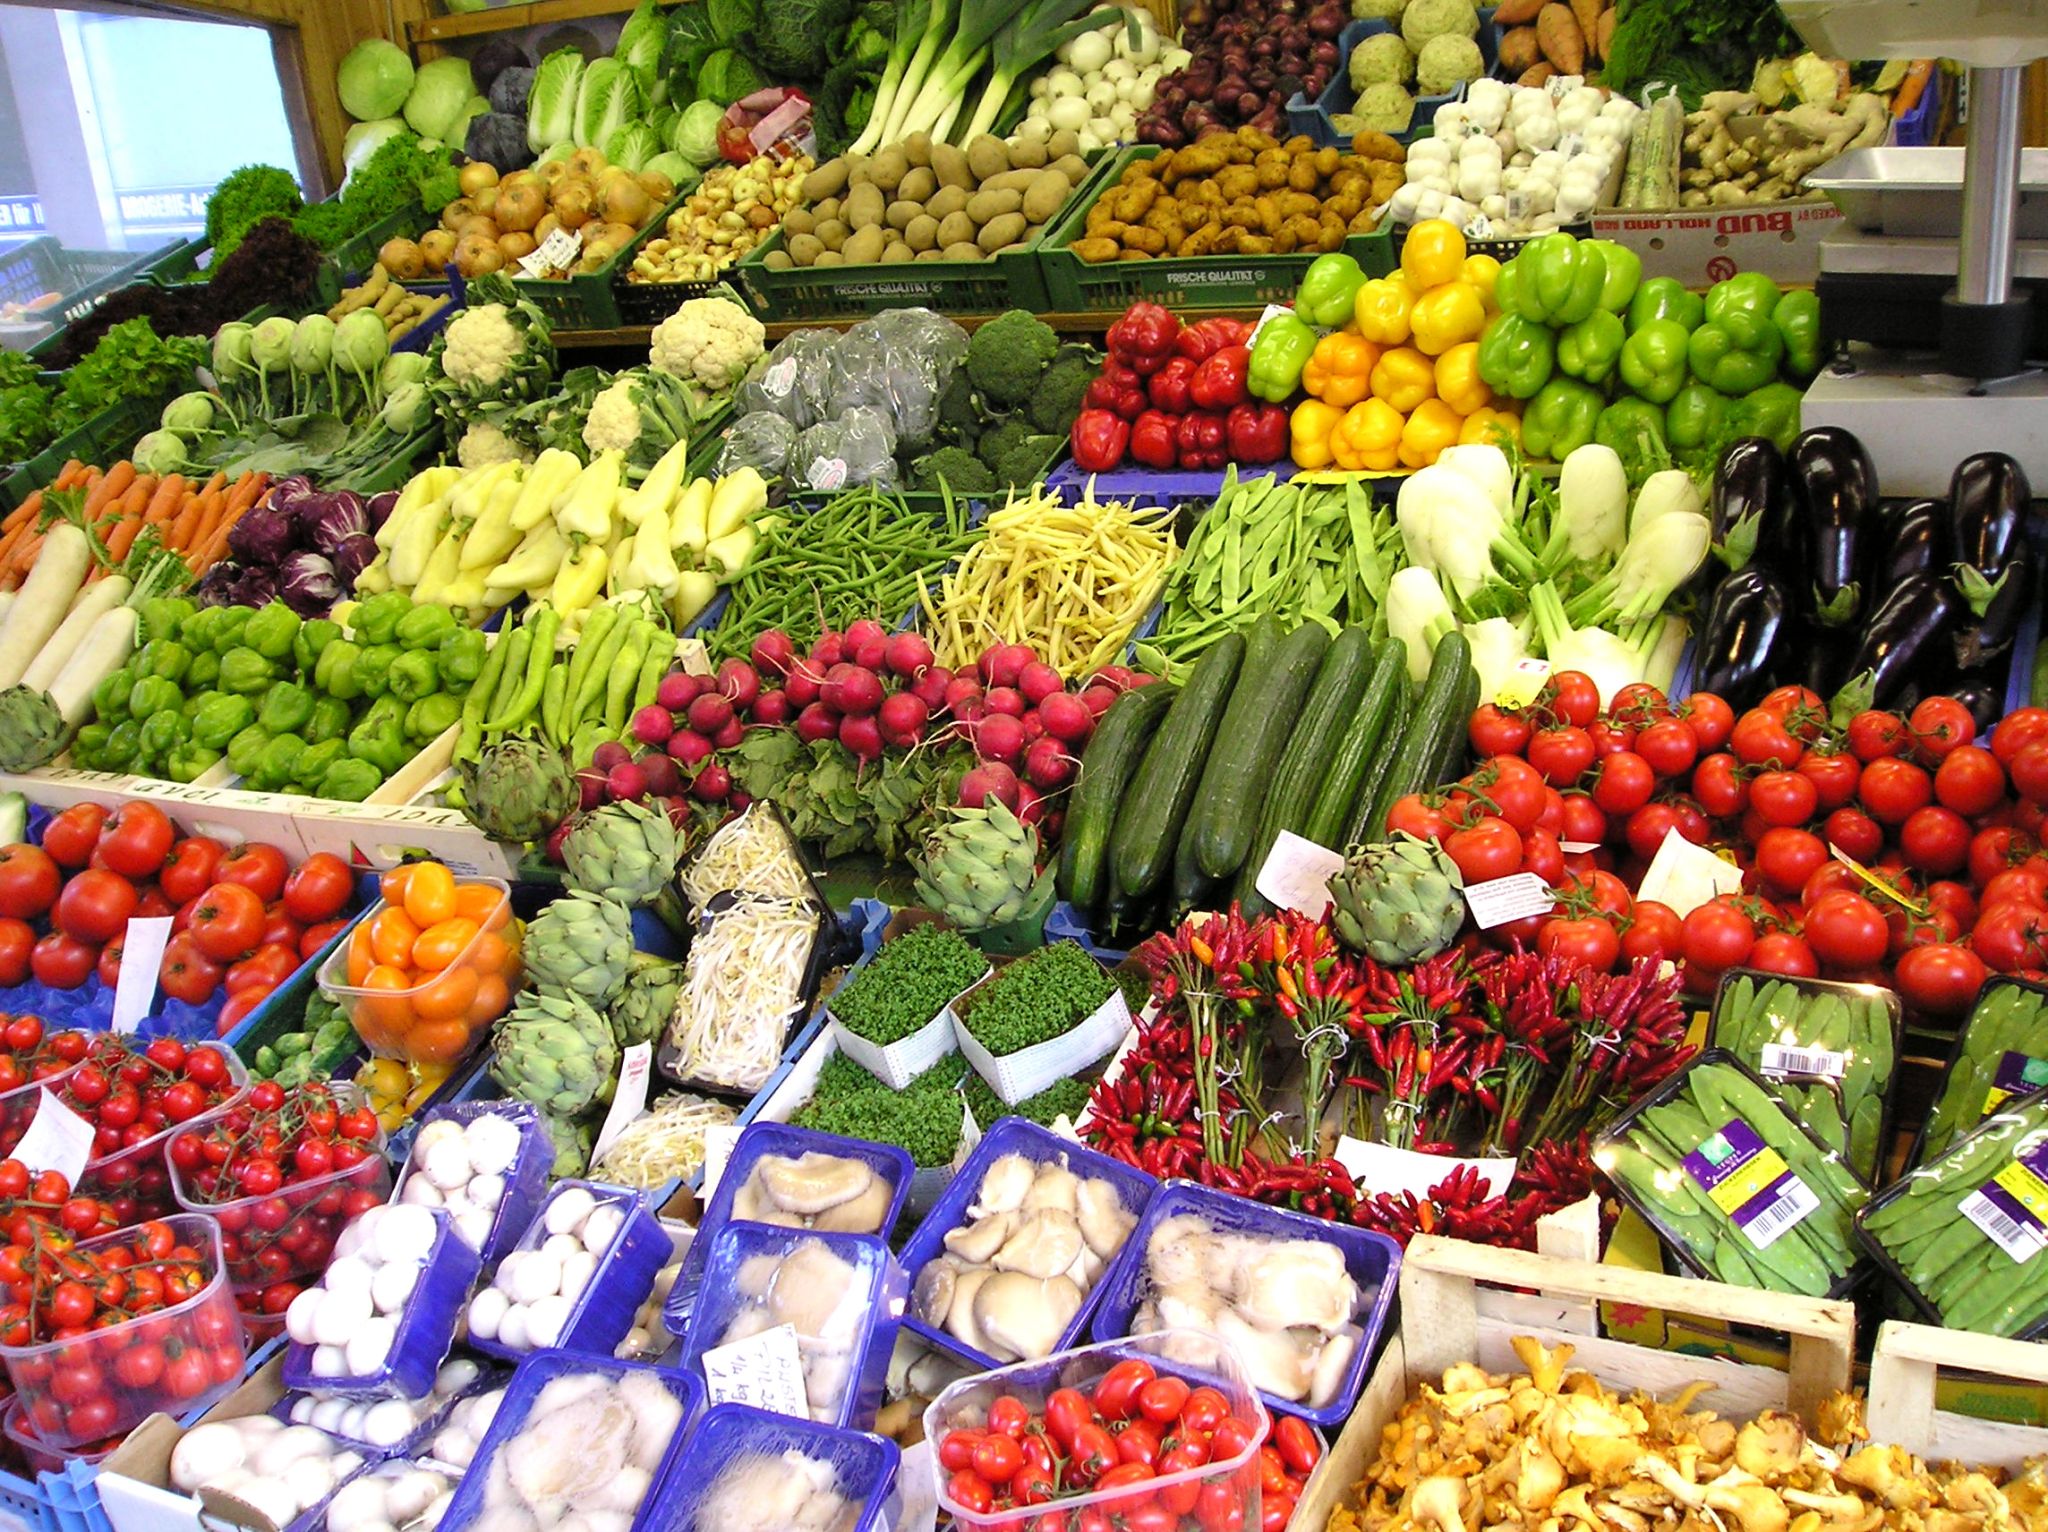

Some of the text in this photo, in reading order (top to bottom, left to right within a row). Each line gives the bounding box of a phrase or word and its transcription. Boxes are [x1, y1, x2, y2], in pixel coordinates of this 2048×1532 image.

[1623, 217, 1712, 231] HOLLAND
[1716, 210, 1794, 235] BUD
[1166, 271, 1207, 284] FRISCHE
